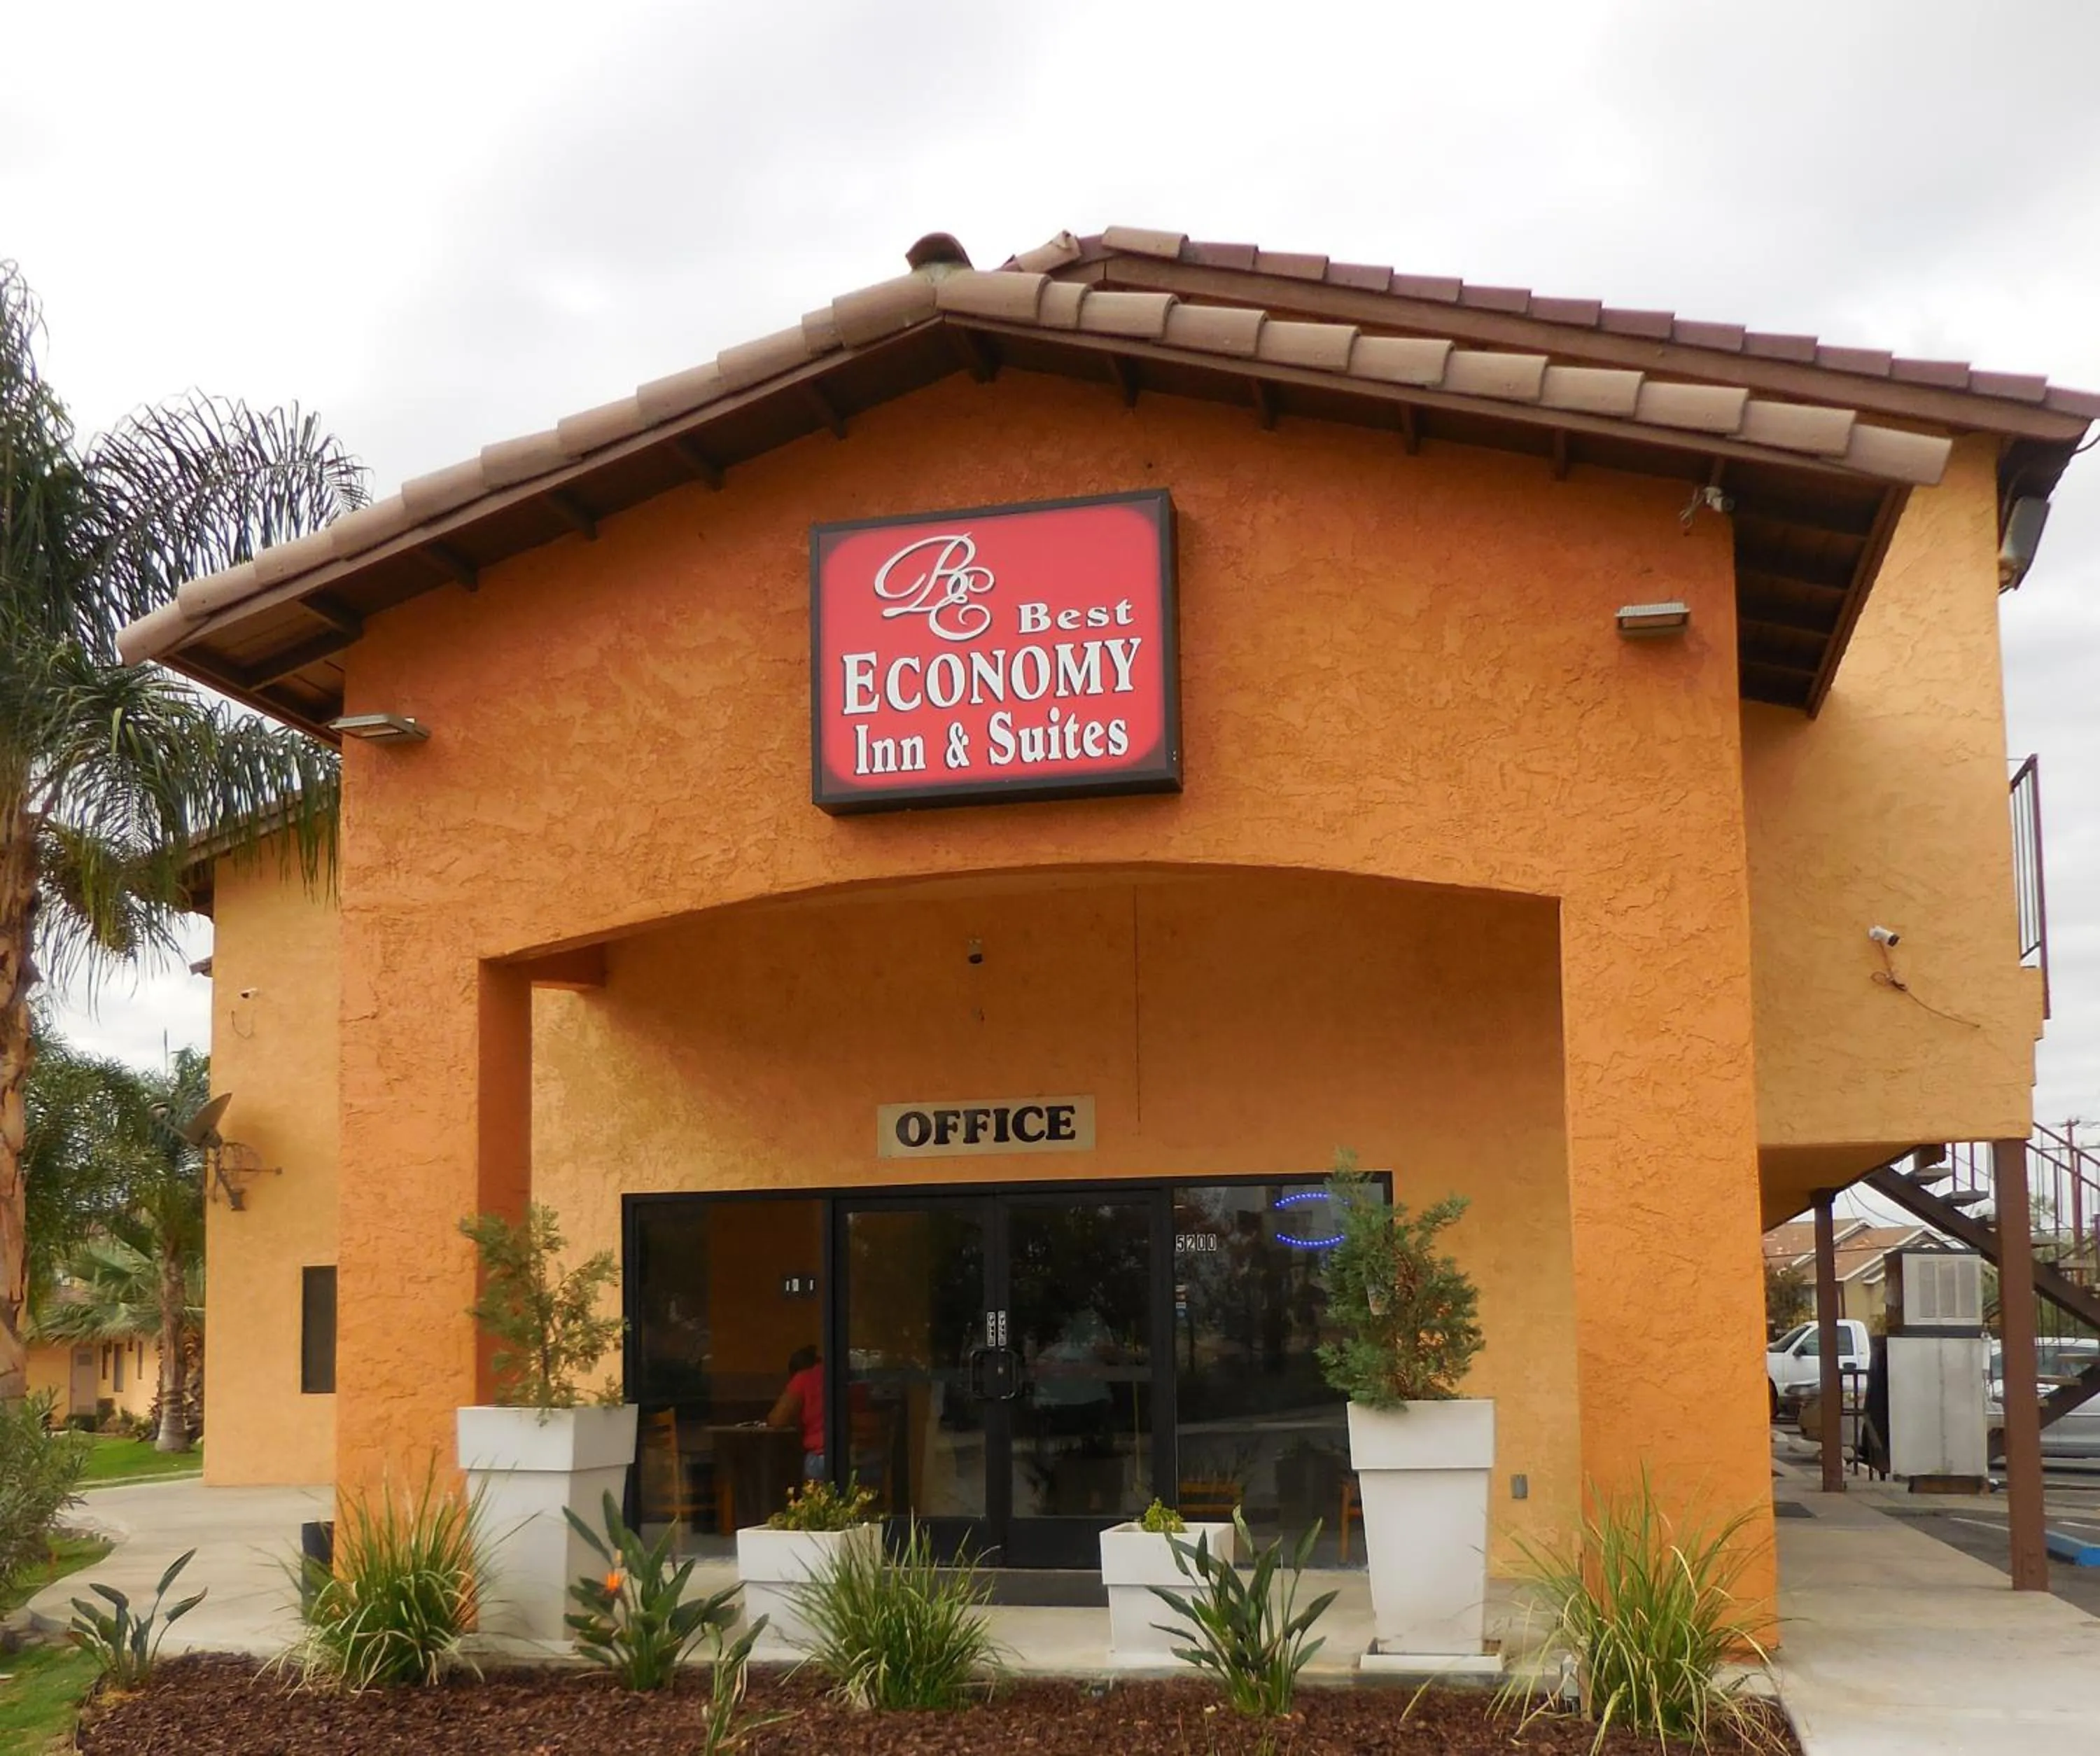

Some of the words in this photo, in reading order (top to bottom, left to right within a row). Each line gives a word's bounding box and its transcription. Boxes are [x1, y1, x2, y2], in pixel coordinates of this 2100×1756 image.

[1018, 599, 1134, 633] Best
[842, 638, 1141, 714] ECONOMY
[855, 724, 926, 774] Inn
[946, 721, 970, 769] &
[988, 706, 1129, 765] Suites
[895, 1106, 1076, 1147] OFFICE
[1176, 1234, 1217, 1251] 5200
